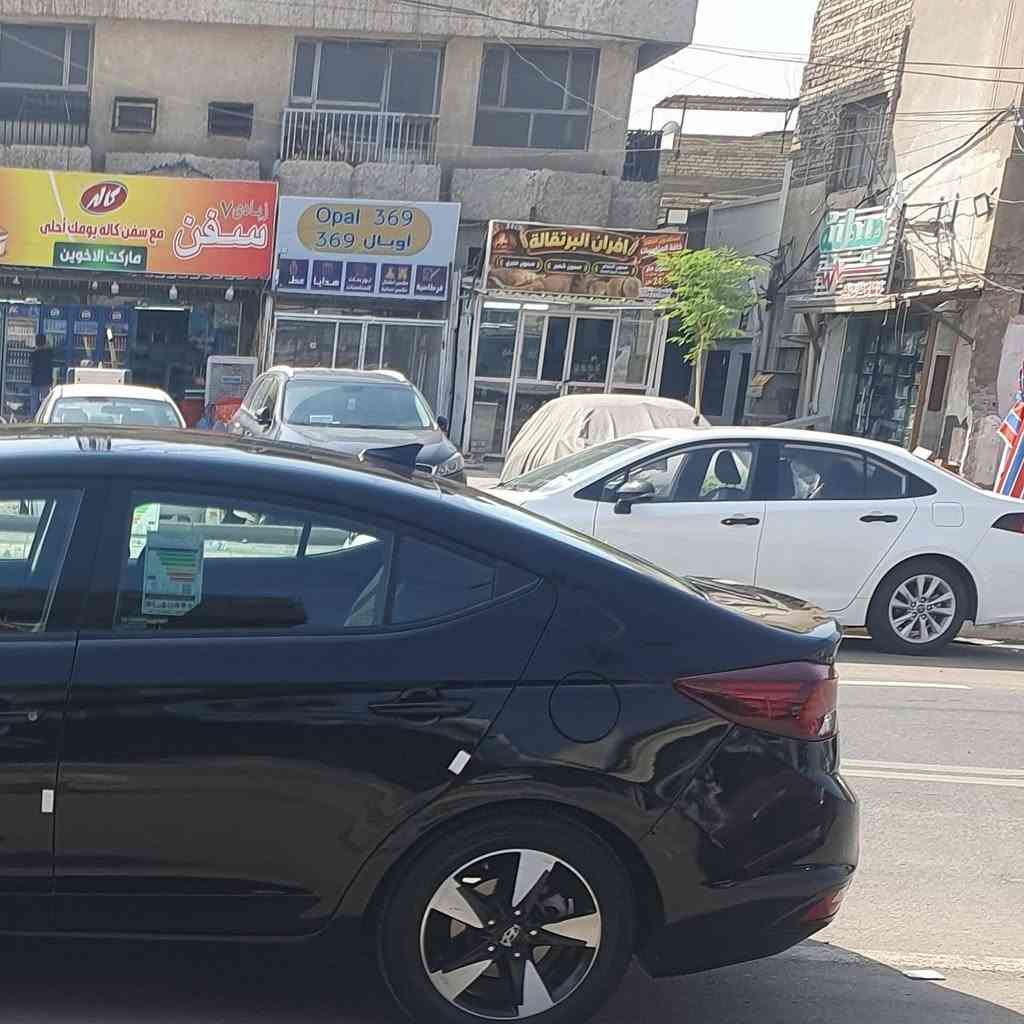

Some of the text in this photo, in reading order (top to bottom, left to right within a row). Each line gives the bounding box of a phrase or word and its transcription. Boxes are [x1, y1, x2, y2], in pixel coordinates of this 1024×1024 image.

[316, 206, 414, 227] Opal 369
[67, 221, 98, 239] يومك
[99, 222, 121, 236] كاله
[121, 226, 148, 239] سفن
[148, 227, 164, 244] مع
[174, 208, 268, 259] سفن
[316, 231, 355, 249] 369
[528, 230, 592, 251] البرتقالة
[60, 246, 142, 267] ماركت الاخوين
